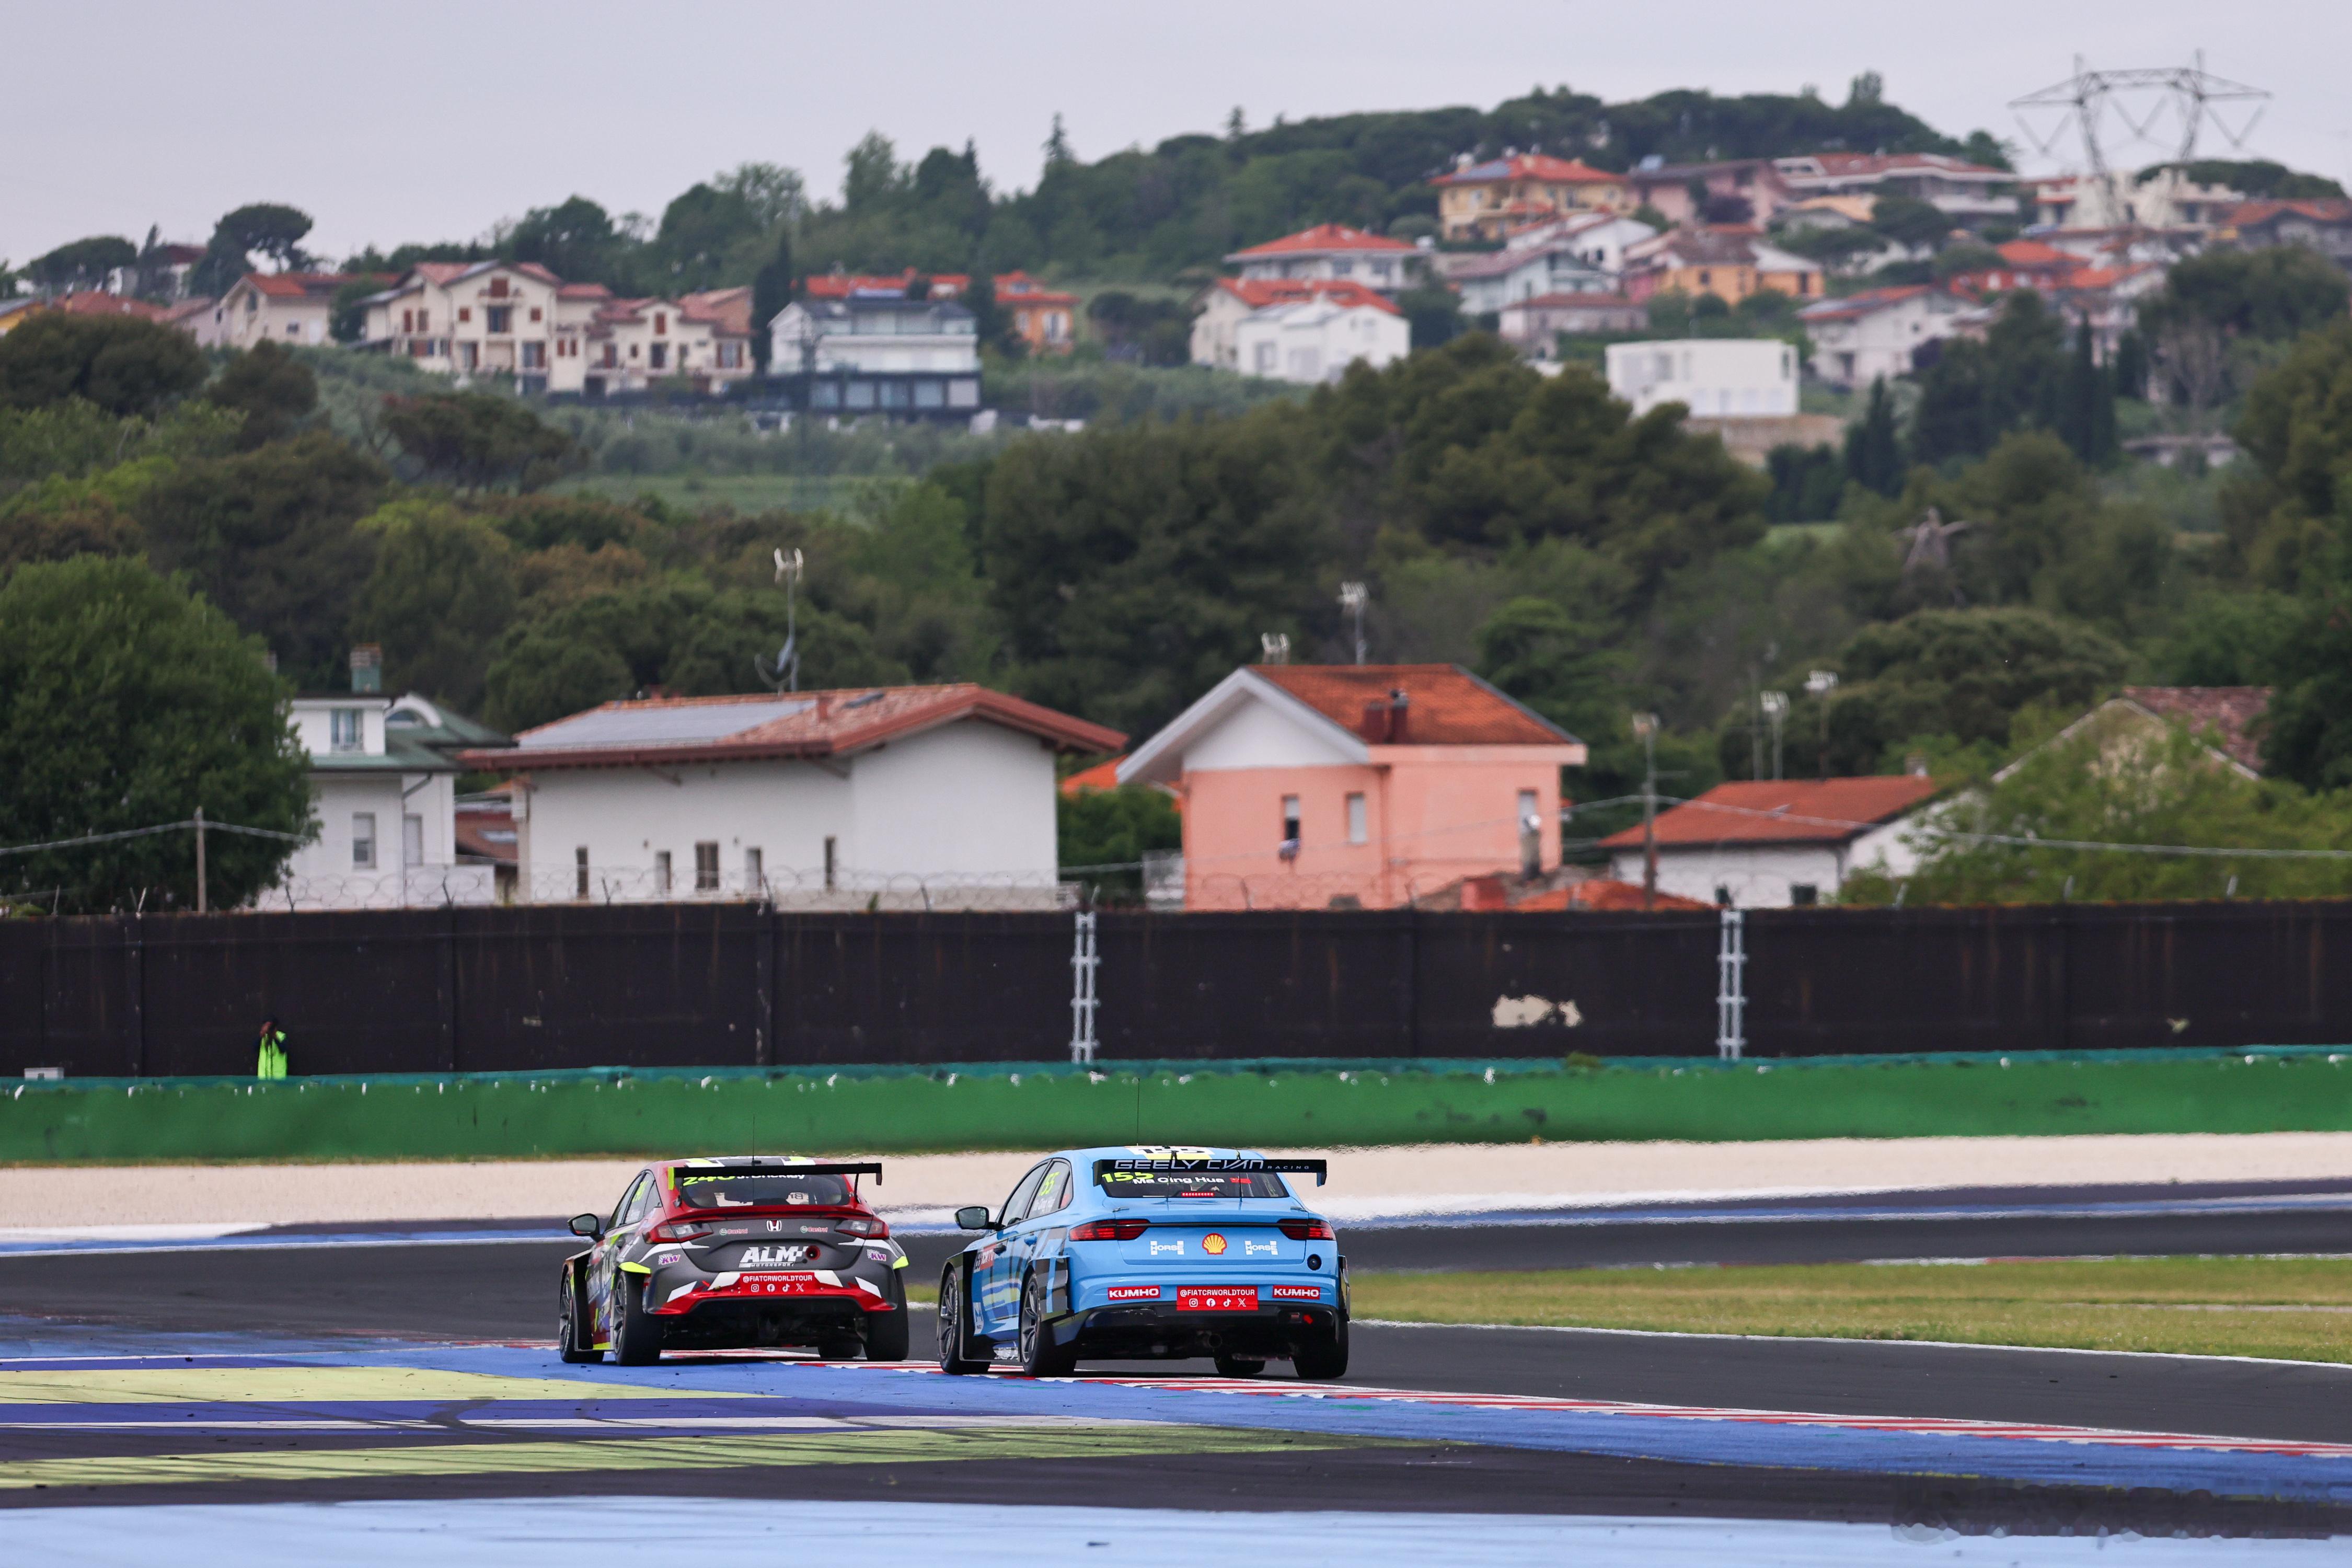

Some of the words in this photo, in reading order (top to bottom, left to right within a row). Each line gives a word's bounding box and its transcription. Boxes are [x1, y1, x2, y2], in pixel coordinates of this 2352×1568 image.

[1114, 1159, 1200, 1170] GEELY
[1101, 1172, 1154, 1183] 155
[1150, 1243, 1184, 1253] HORSE
[1245, 1243, 1278, 1253] HORSE
[661, 1254, 680, 1264] KW
[740, 1246, 801, 1263] ALM
[871, 1253, 886, 1262] KW
[742, 1275, 813, 1283] @FIATCRWORLDTOUR
[1109, 1287, 1159, 1298] KUMHO
[1180, 1288, 1255, 1298] @FIATCRWORLDTOUR
[1274, 1288, 1320, 1298] KUMHO
